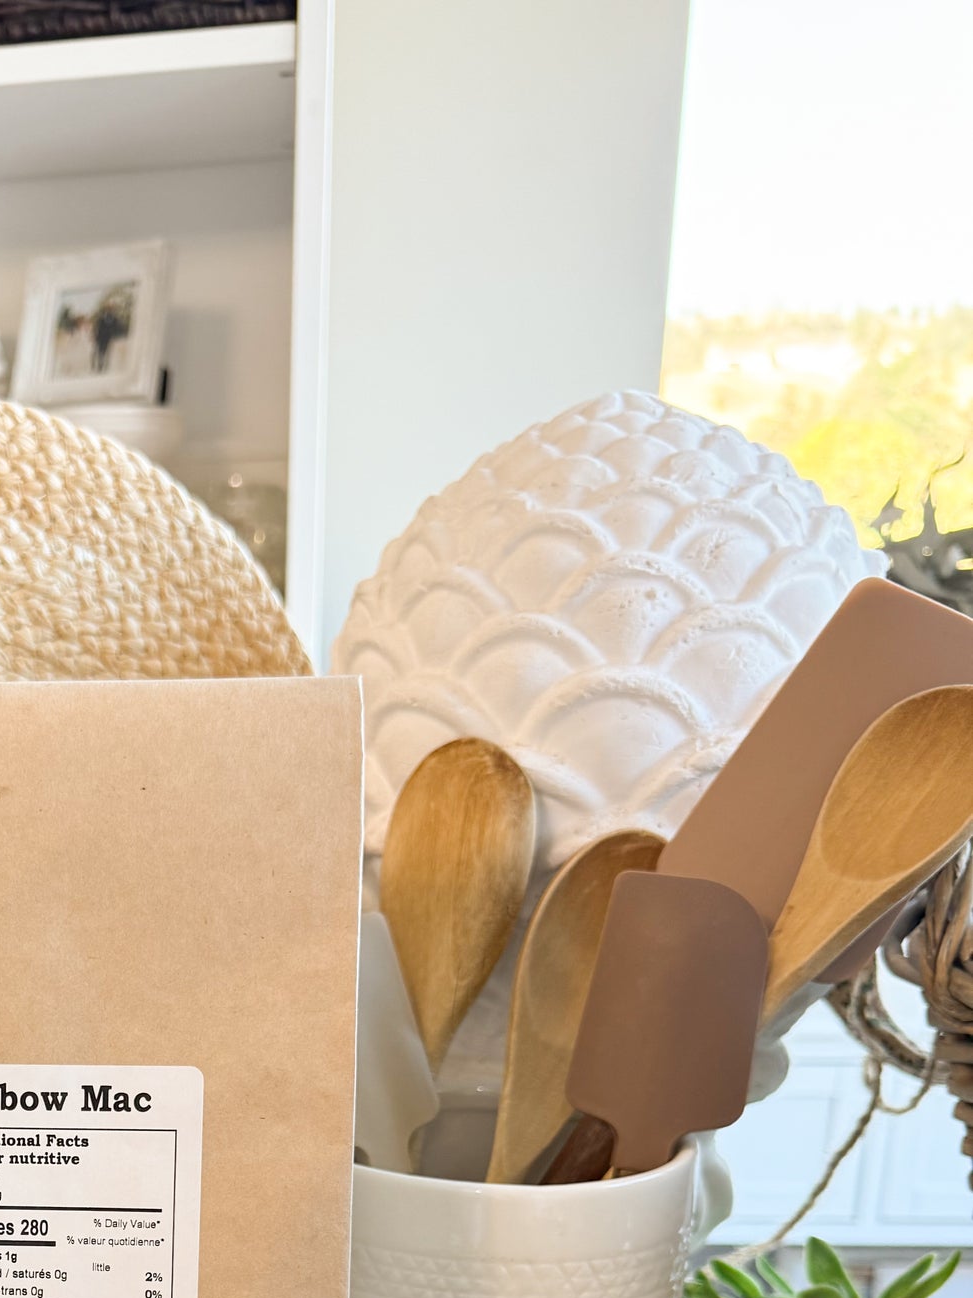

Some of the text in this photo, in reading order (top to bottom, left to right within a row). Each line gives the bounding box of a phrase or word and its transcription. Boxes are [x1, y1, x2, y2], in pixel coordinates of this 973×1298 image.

[81, 1085, 151, 1112] Mac
[46, 1134, 89, 1147] Facts
[9, 1152, 80, 1165] nutritive
[20, 1219, 48, 1236] 280
[94, 1218, 102, 1227] %
[105, 1219, 128, 1230] Daily
[67, 1235, 75, 1245] %
[78, 1237, 106, 1245] valeur
[5, 1251, 17, 1263] 1g
[92, 1262, 110, 1272] little
[12, 1269, 51, 1279] saturés
[54, 1269, 67, 1282] 0g
[145, 1272, 163, 1282] 2%
[1, 1286, 27, 1296] trans
[31, 1286, 43, 1298] 0g
[145, 1290, 162, 1298] 0%
